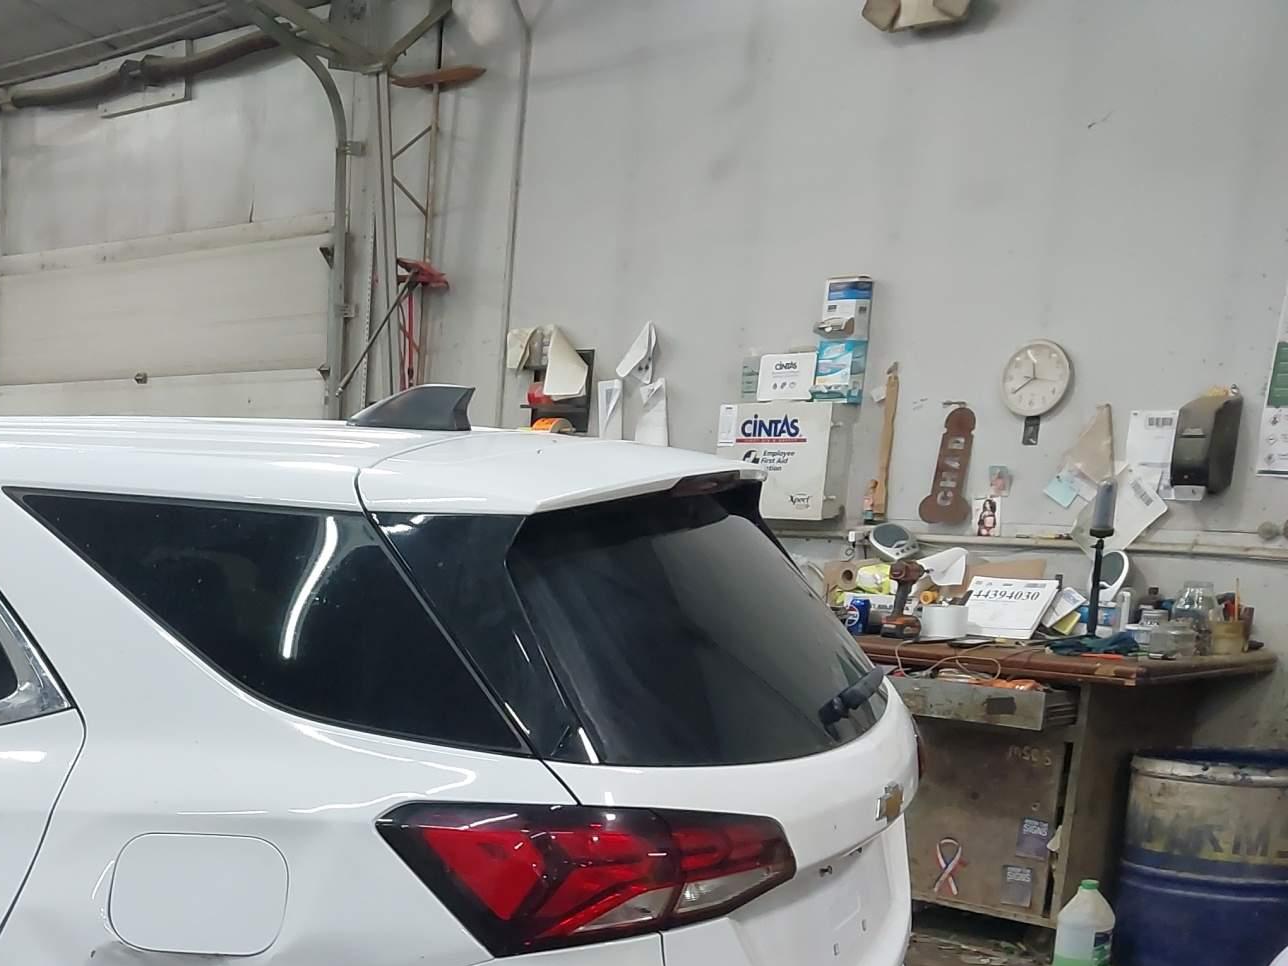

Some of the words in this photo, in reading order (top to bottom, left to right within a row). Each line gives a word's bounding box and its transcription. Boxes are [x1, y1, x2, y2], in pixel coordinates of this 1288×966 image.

[740, 413, 801, 438] CINTAS
[763, 450, 796, 459] Employee
[972, 589, 1041, 601] 44394030
